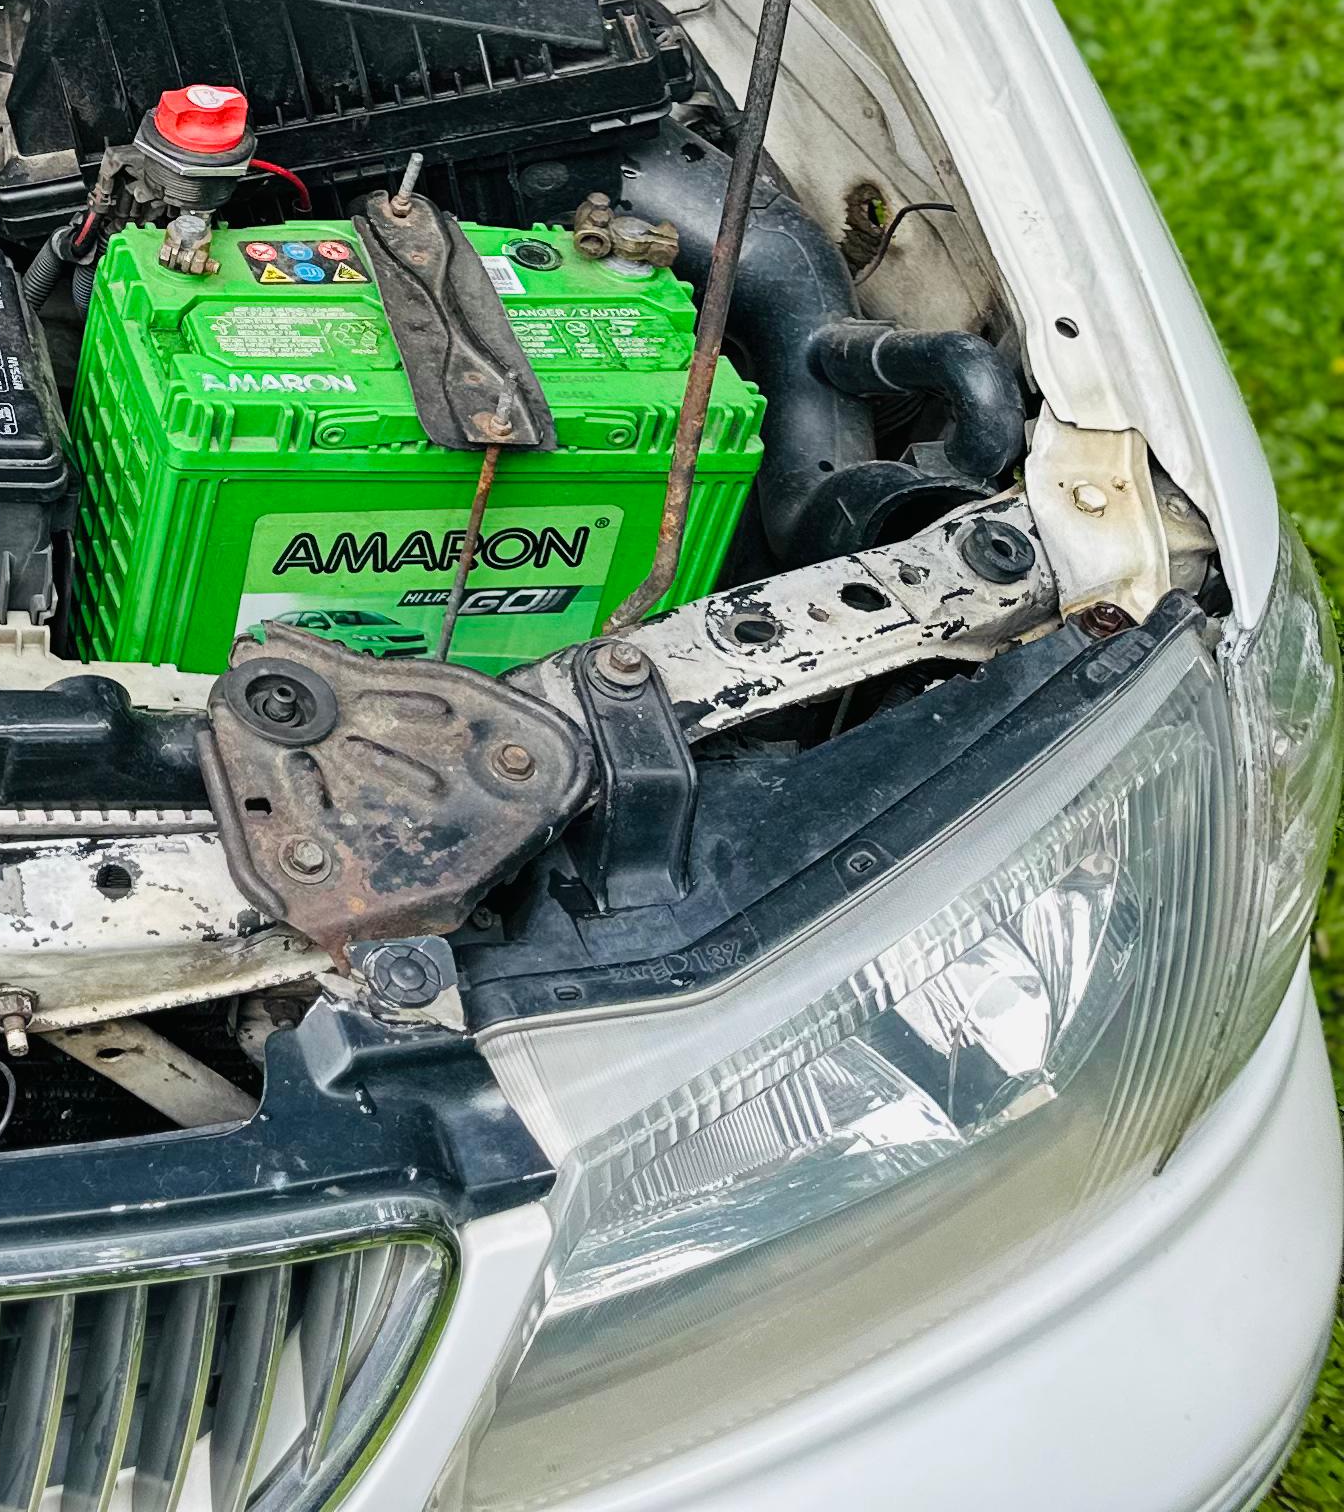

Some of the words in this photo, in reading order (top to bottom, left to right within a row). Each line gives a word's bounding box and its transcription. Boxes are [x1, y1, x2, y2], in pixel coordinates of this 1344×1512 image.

[507, 308, 566, 317] DANGER
[580, 308, 641, 317] CAUTION
[201, 373, 358, 393] AMARON
[272, 525, 591, 576] AMARON
[403, 592, 422, 603] HI
[425, 591, 451, 603] LIF
